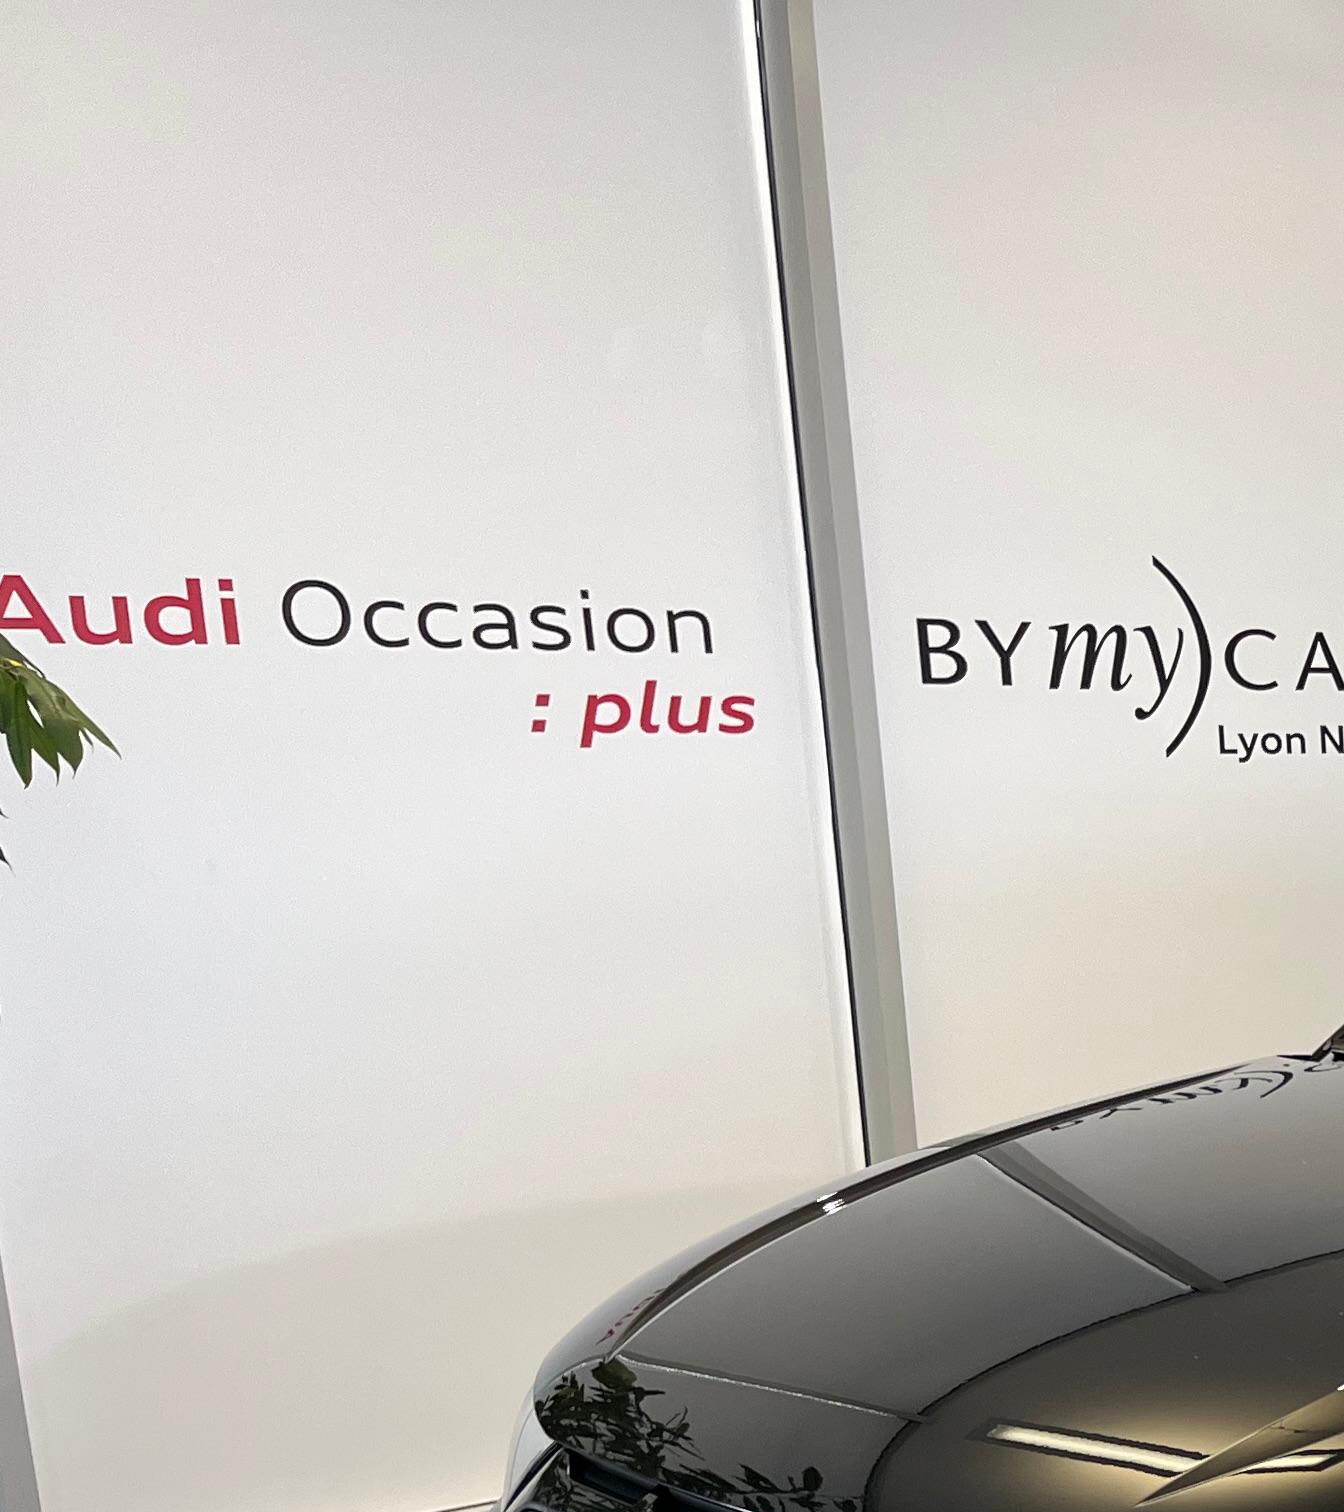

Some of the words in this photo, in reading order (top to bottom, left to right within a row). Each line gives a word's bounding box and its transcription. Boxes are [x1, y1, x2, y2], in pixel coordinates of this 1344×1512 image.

[0, 575, 240, 645] Audi
[282, 580, 713, 654] Occasion
[1218, 725, 1306, 763] Lyon
